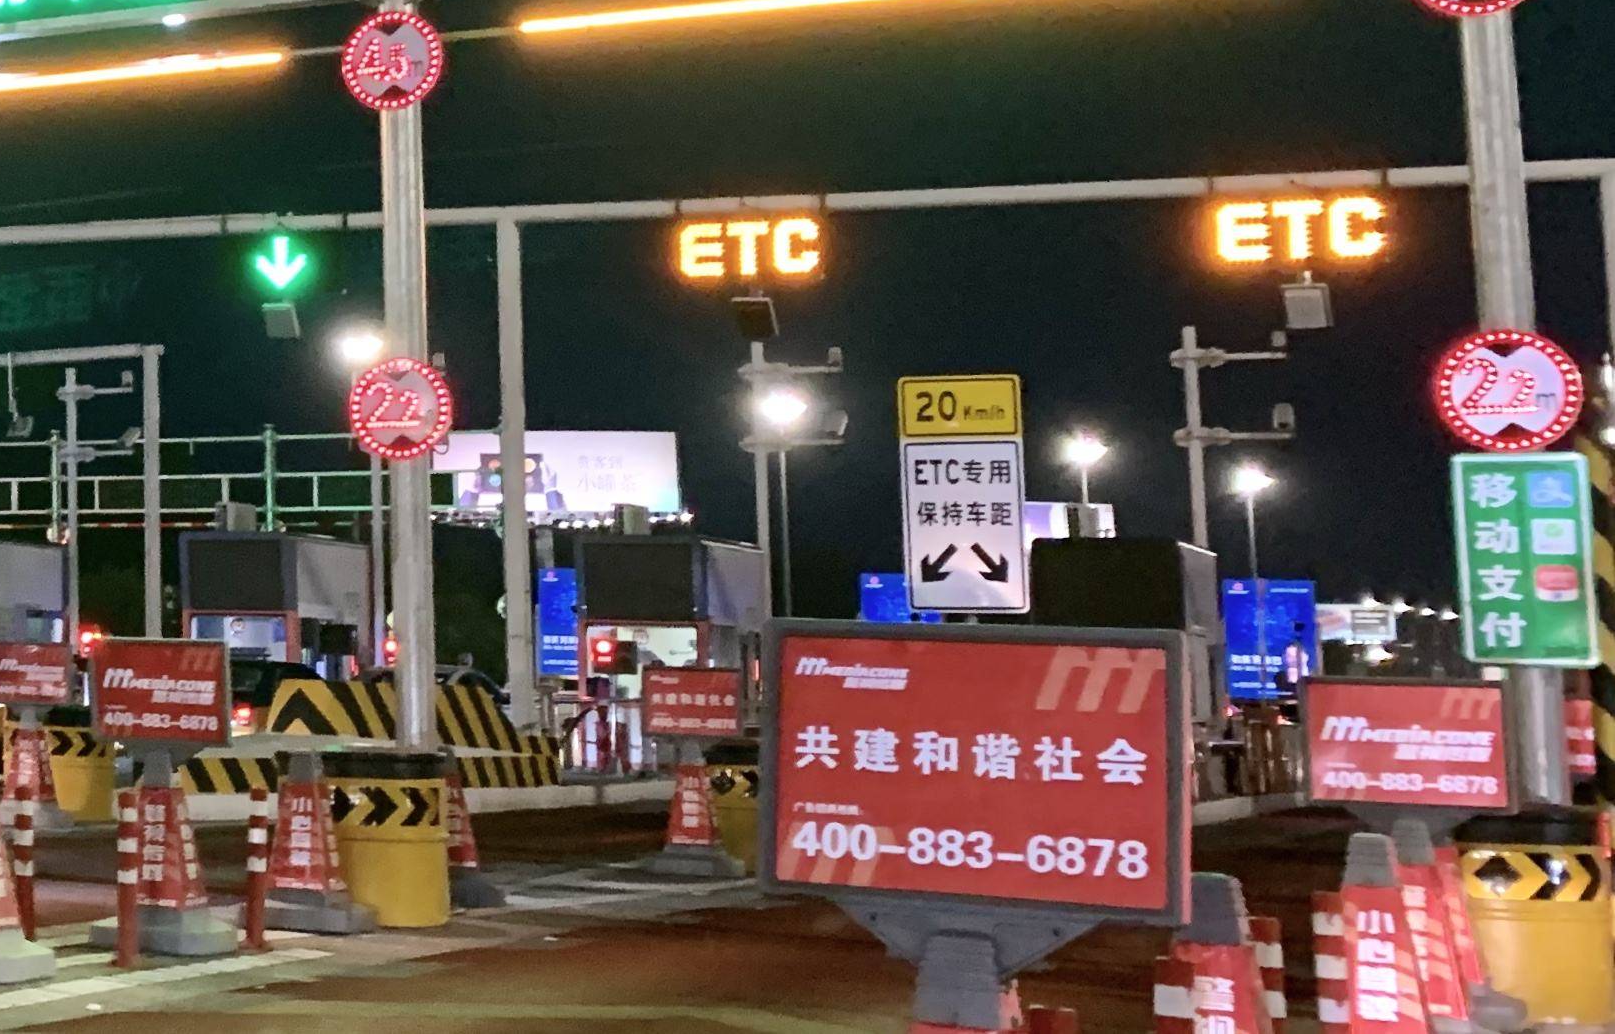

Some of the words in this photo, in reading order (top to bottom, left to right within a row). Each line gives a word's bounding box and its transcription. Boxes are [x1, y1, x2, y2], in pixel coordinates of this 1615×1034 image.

[678, 218, 820, 277] ETC
[1216, 196, 1387, 262] ETC
[916, 390, 957, 422] 20
[914, 459, 1011, 485] ETC专用
[916, 500, 1013, 526] 保持车距
[1469, 472, 1527, 648] 移动支付
[795, 725, 1148, 786] 共建和谐社会
[792, 821, 1149, 880] 400-883-6878
